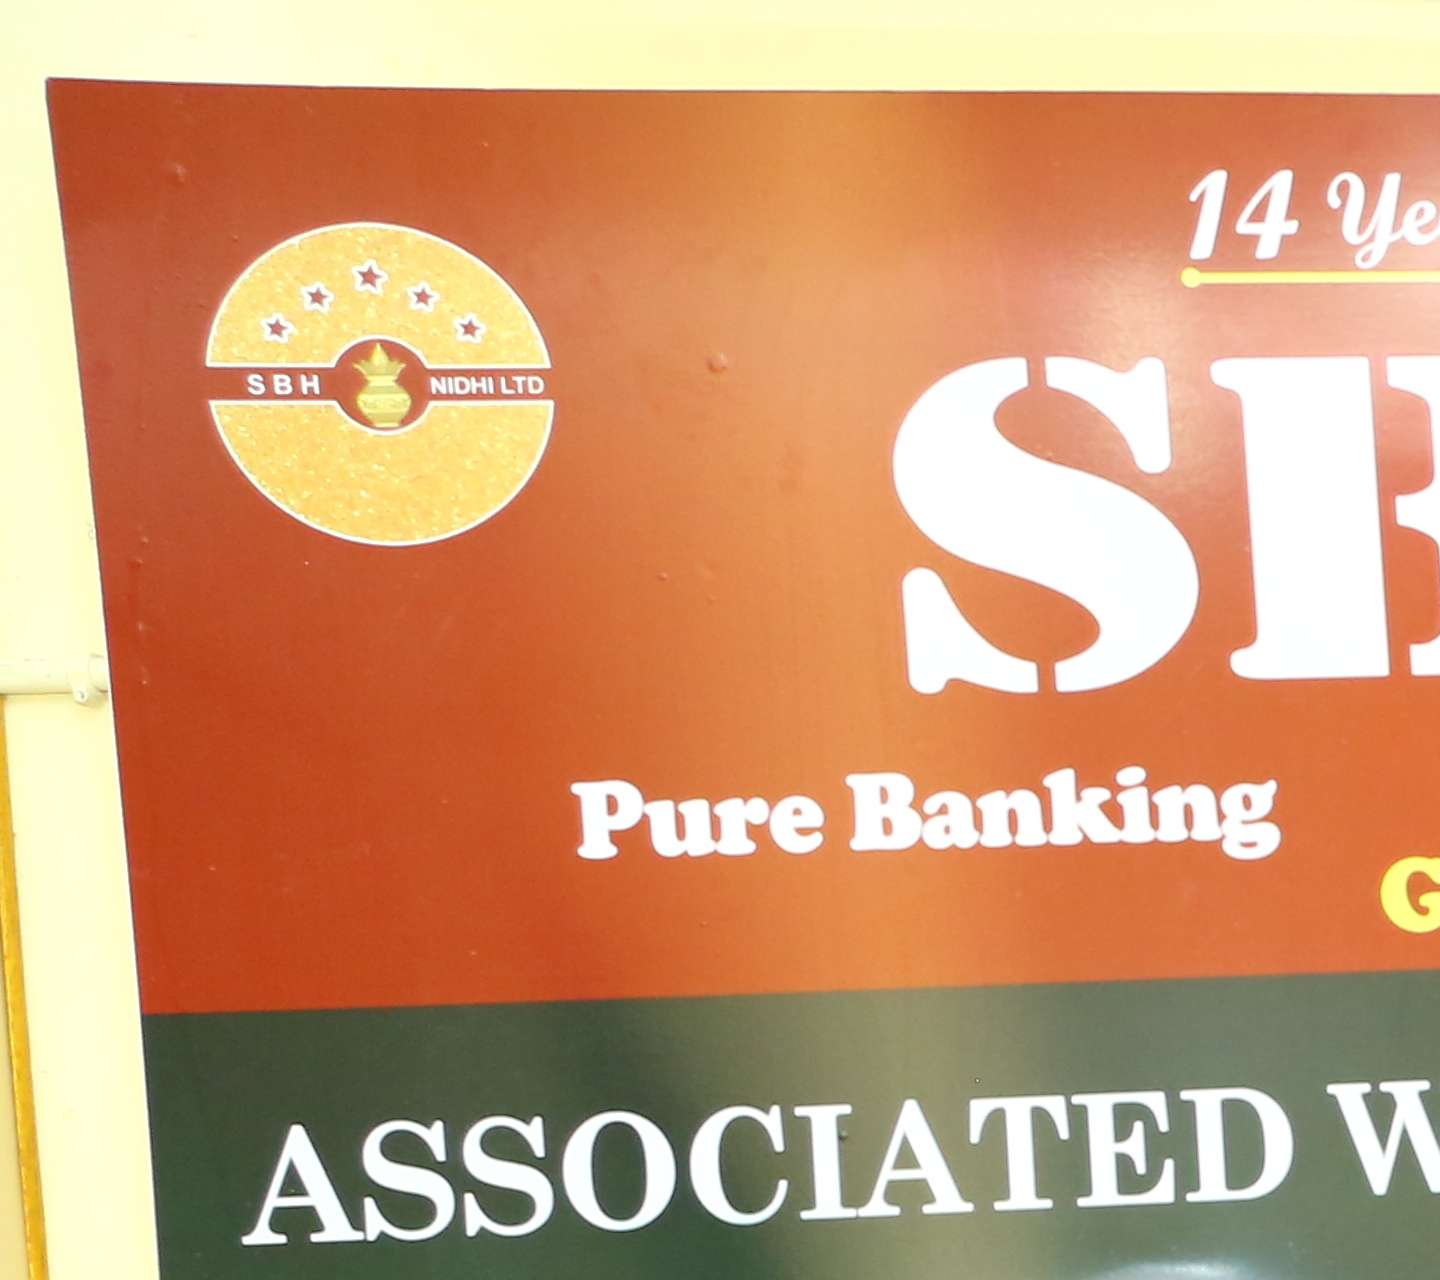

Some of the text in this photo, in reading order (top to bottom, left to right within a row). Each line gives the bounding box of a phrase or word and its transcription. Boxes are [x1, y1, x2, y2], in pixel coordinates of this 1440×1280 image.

[1190, 169, 1299, 261] 14
[430, 375, 495, 396] NIDHI
[500, 375, 546, 395] LTD
[570, 766, 1281, 860] Pure Banking
[241, 1086, 1295, 1246] ASSOCIATED
